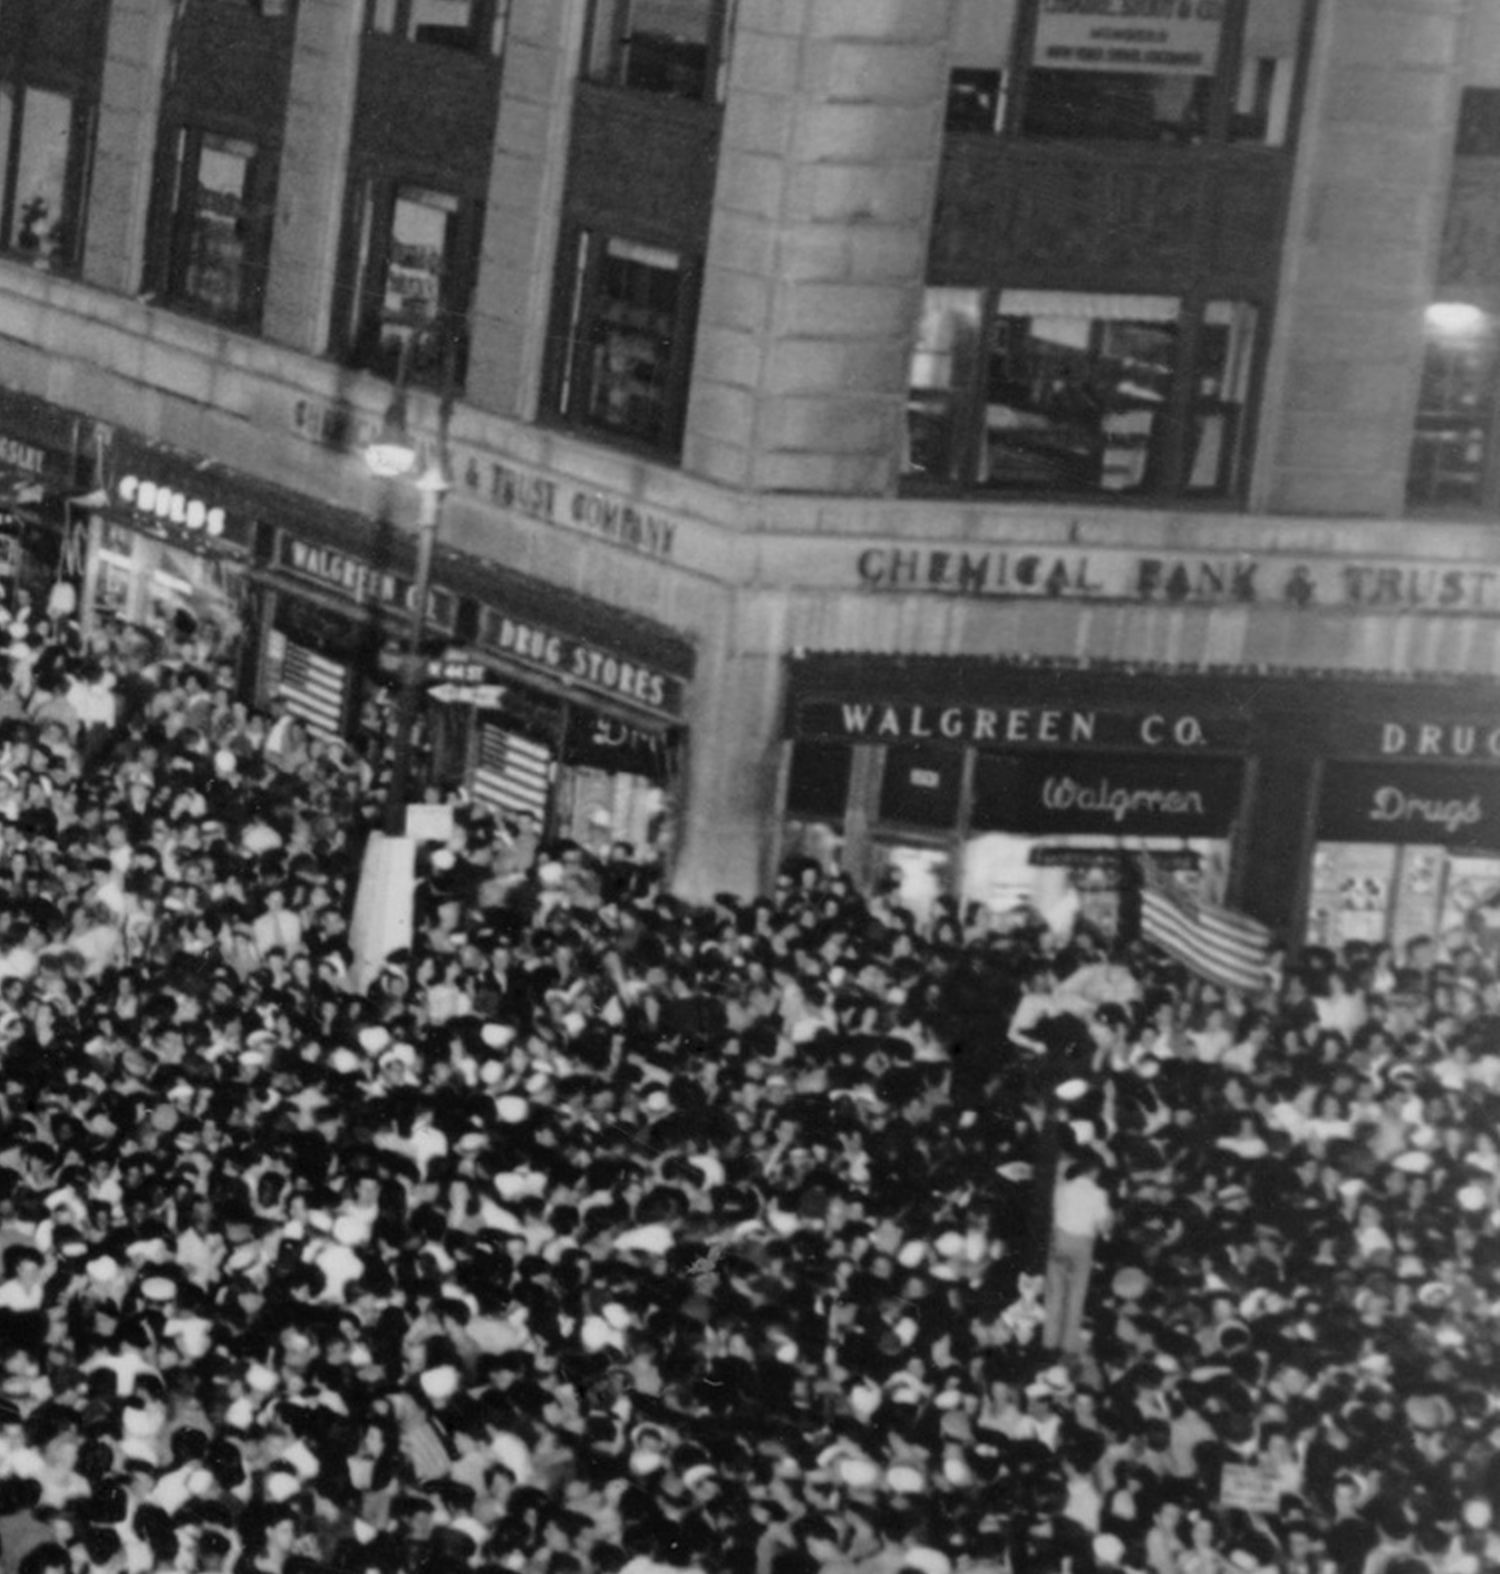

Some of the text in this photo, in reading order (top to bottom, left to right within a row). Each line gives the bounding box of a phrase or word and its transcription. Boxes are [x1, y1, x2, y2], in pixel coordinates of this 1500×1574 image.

[489, 462, 560, 519] TRUST
[570, 492, 680, 555] COMPANY
[290, 539, 396, 602] WALGREEN
[855, 547, 1105, 594] CHEMICAL
[1342, 564, 1497, 608] TRUST
[499, 618, 666, 706] DRUG STORES
[841, 702, 1208, 746] WALGREEN CO.
[1041, 774, 1206, 823] Walgreen
[1368, 784, 1482, 834] Drugs
